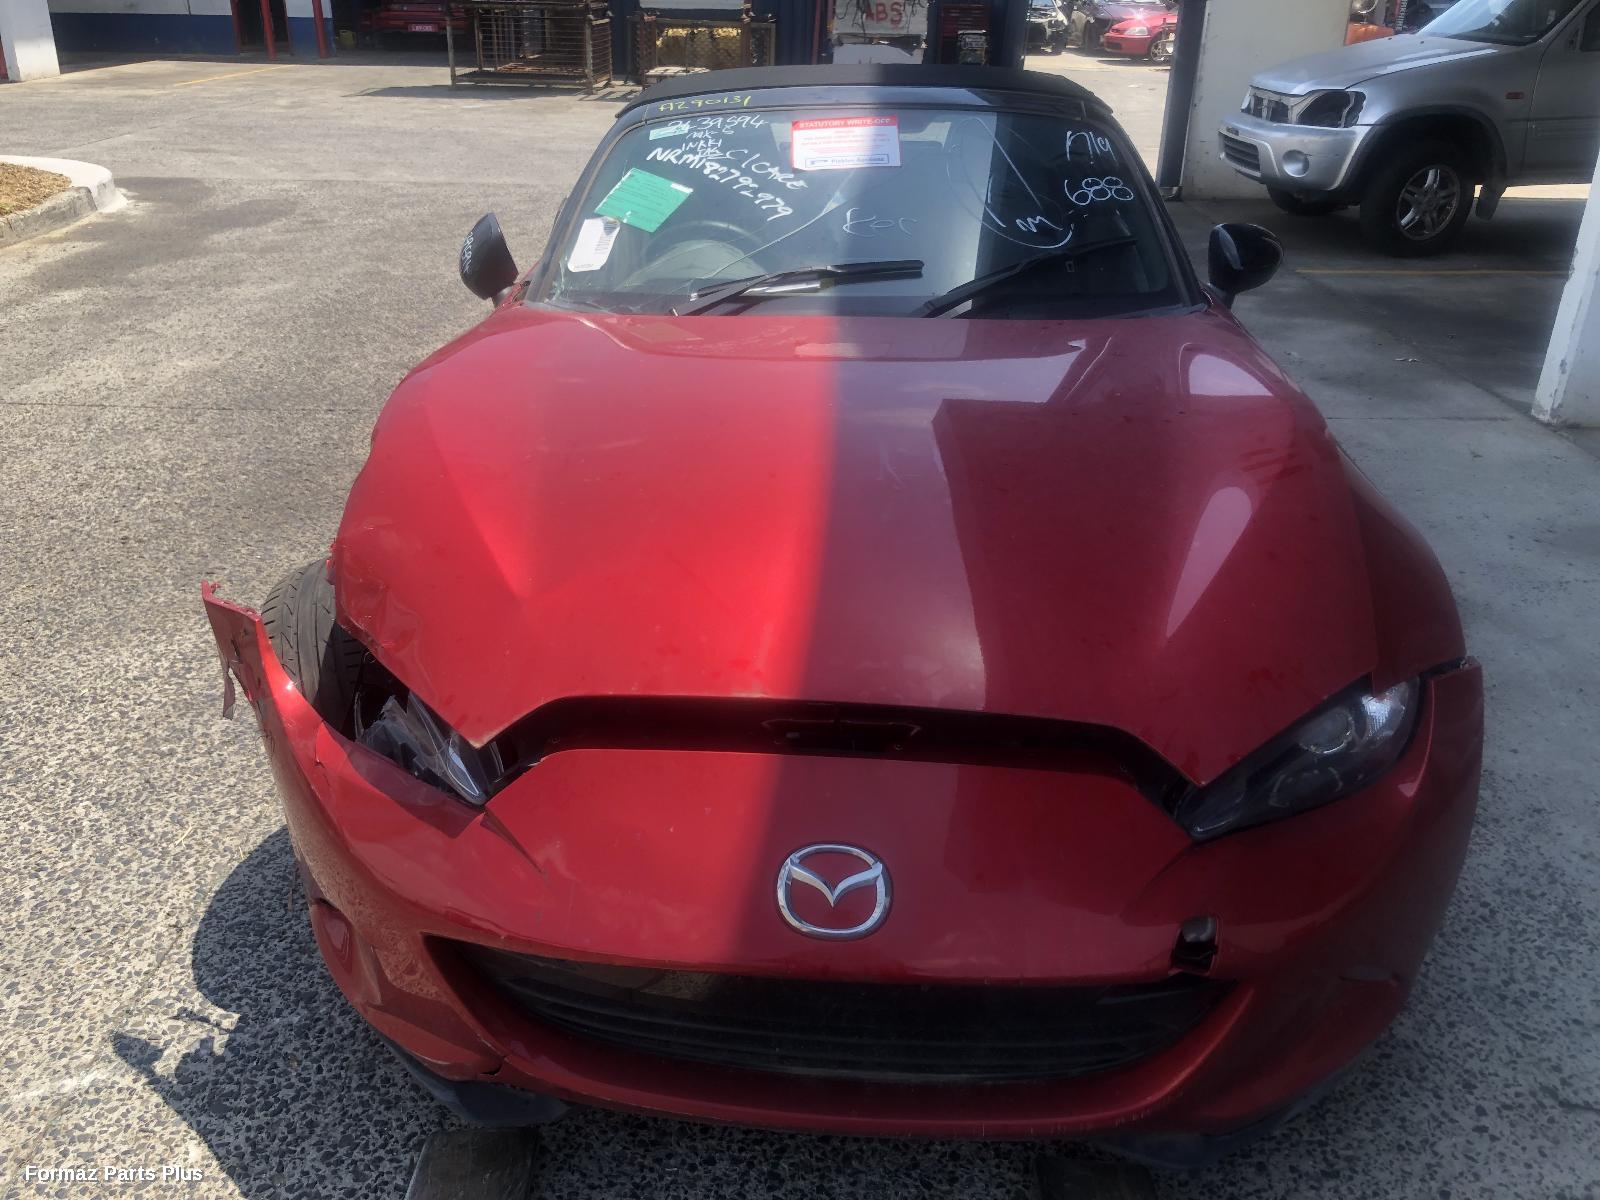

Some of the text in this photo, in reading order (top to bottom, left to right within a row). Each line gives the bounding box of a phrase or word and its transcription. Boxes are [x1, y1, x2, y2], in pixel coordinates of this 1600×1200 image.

[865, 1, 904, 25] ABS
[799, 117, 891, 129] STATUTORY WRITE-OFF
[1064, 176, 1135, 206] 688
